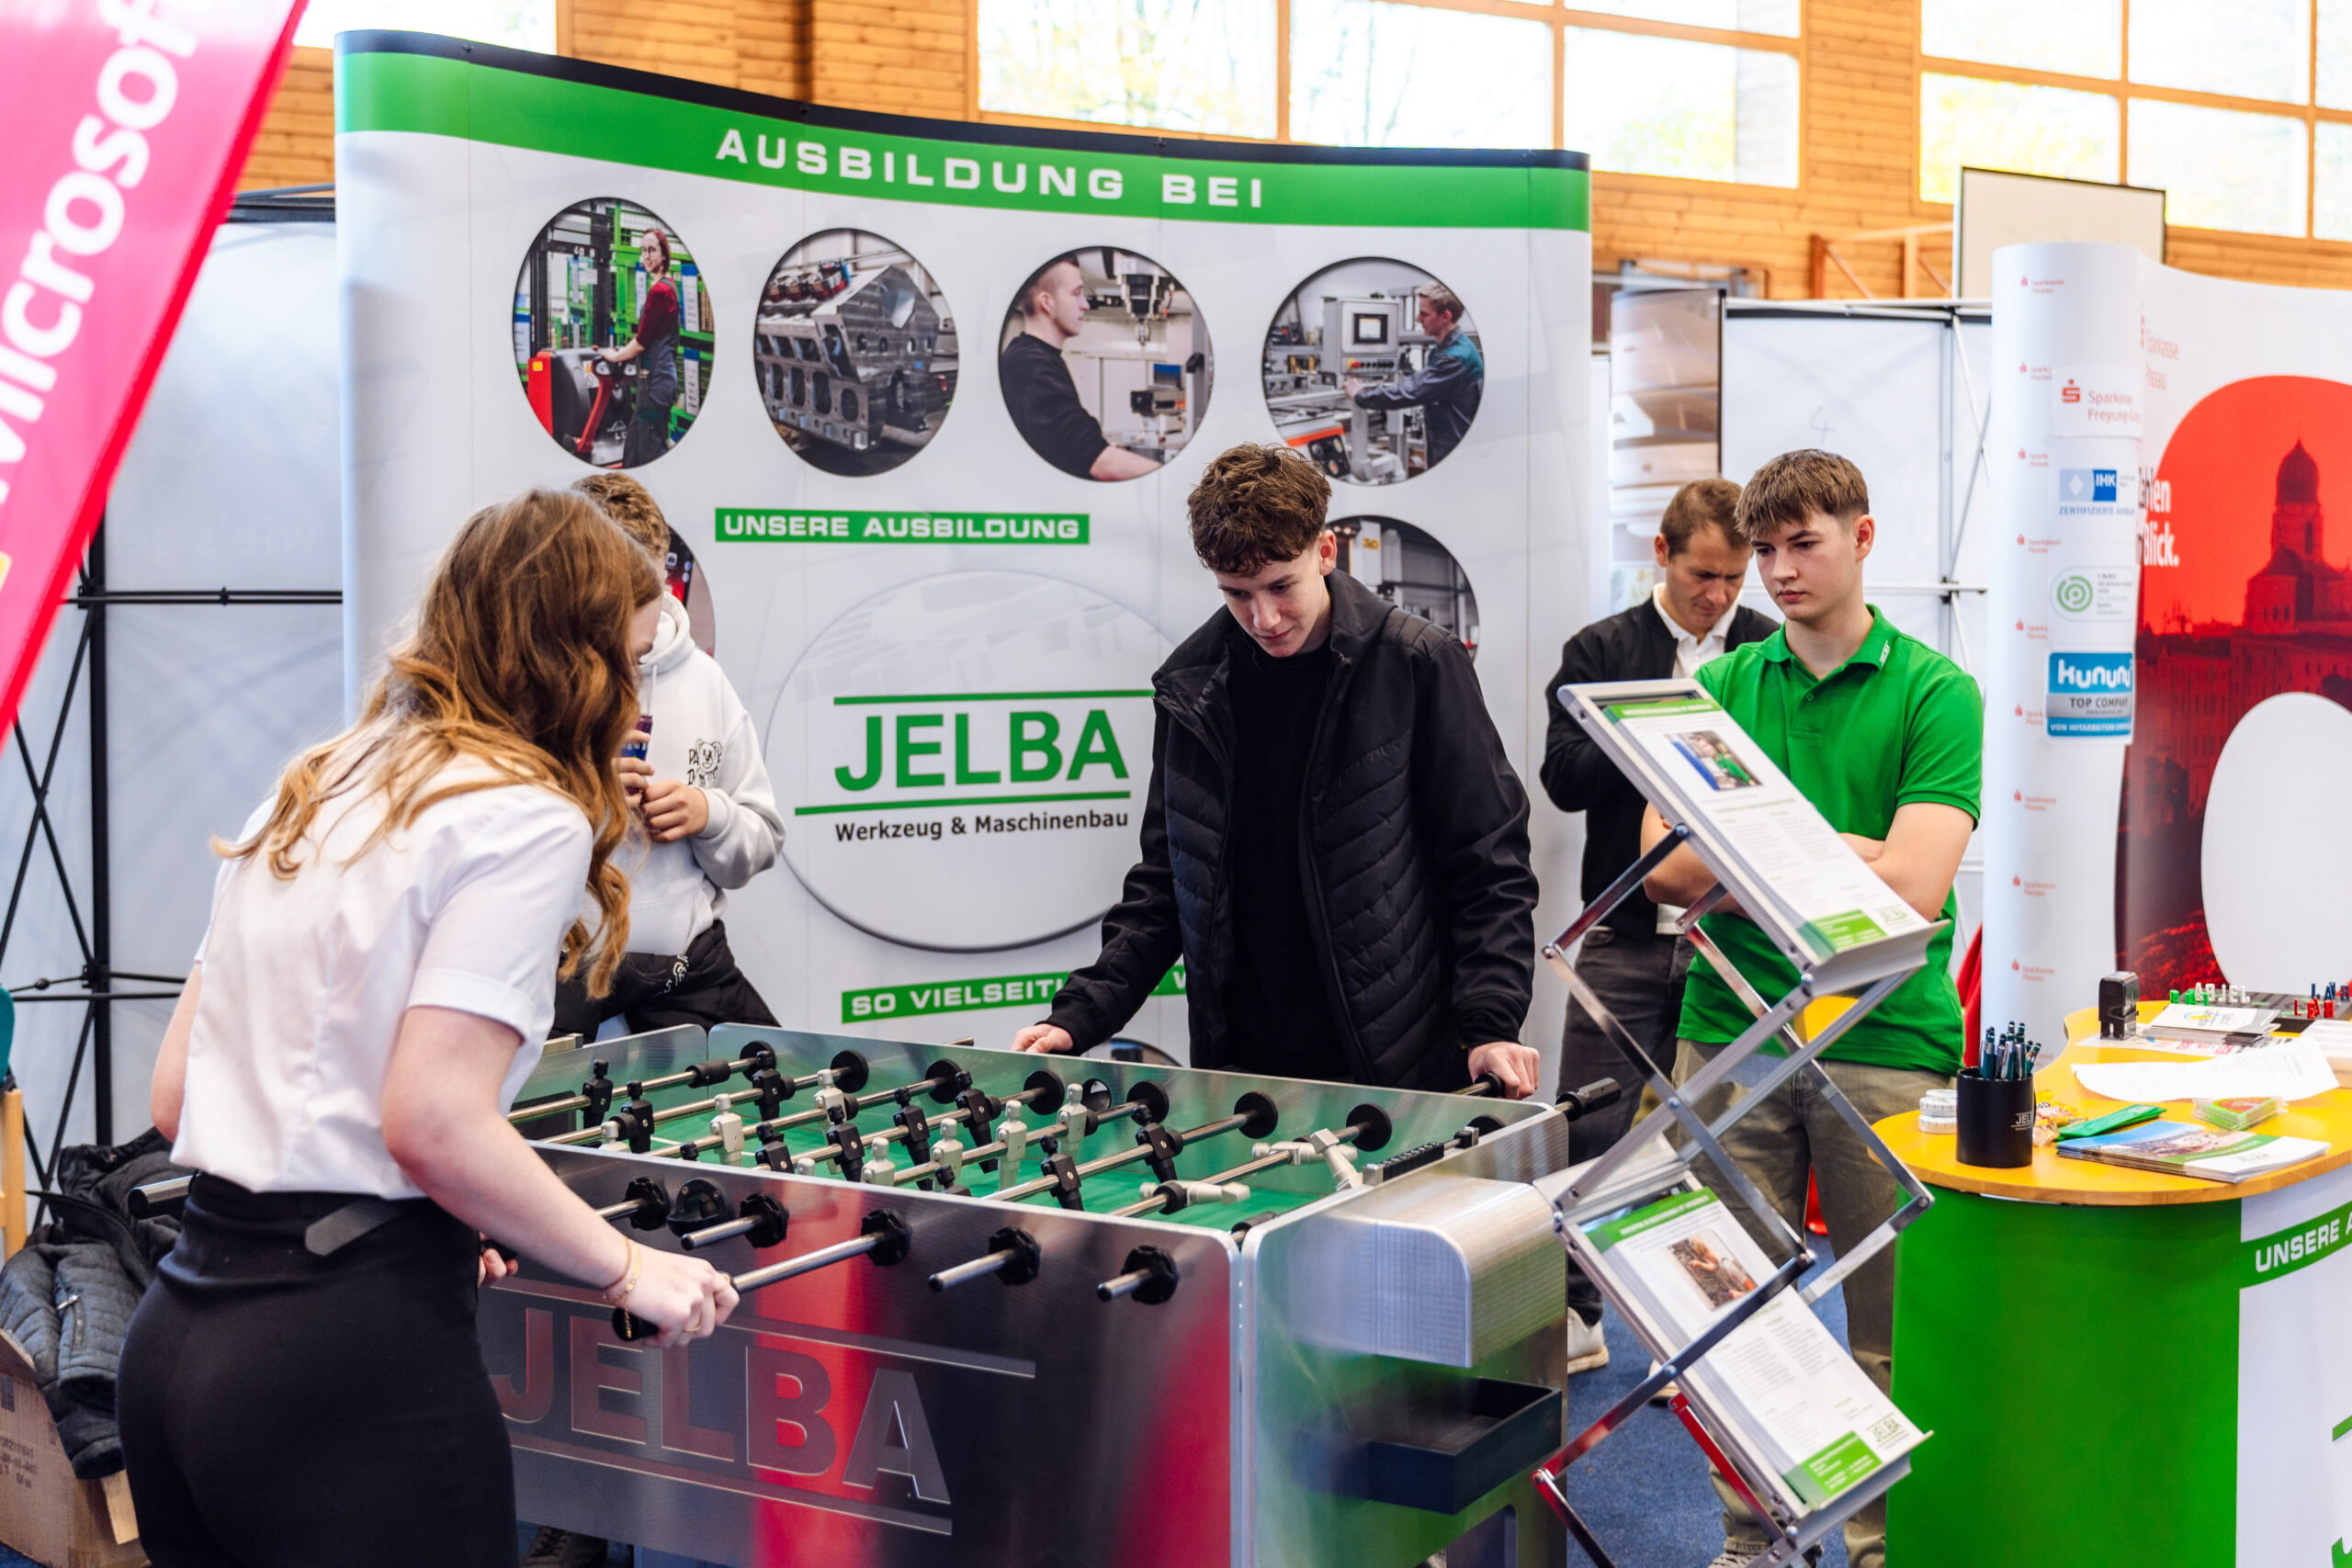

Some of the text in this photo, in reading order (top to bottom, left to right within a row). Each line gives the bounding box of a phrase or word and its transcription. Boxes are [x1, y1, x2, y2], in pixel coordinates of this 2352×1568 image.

[716, 129, 1261, 208] AUSBILDUNG BEI
[2096, 473, 2116, 488] IHK
[725, 515, 1080, 539] UNSERE AUSBILDUNG
[2058, 659, 2131, 689] kununu
[2069, 697, 2092, 708] TOP
[835, 709, 1130, 791] JELBA
[836, 810, 1128, 842] Werkzeug & Maschinenbau
[852, 995, 897, 1017] SO
[2256, 1218, 2340, 1273] UNSERE
[489, 1308, 952, 1504] JELBA
